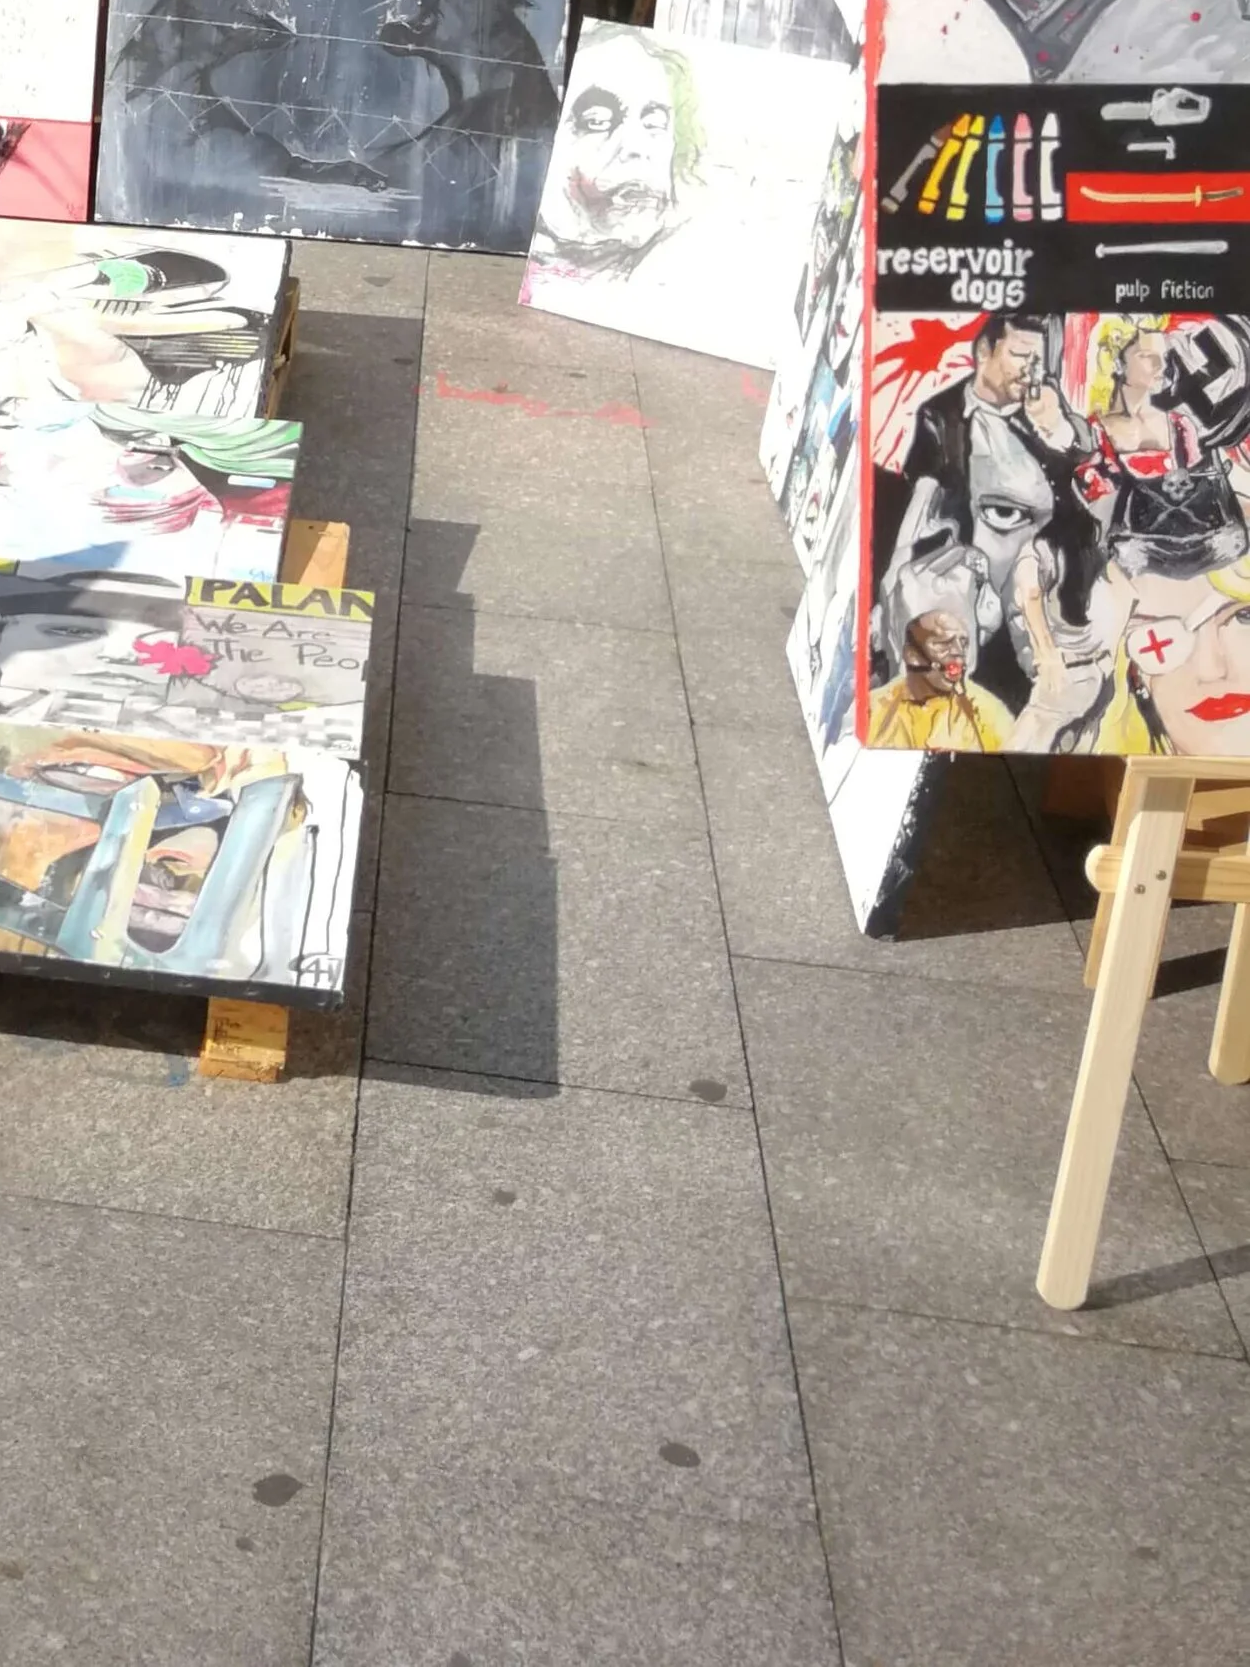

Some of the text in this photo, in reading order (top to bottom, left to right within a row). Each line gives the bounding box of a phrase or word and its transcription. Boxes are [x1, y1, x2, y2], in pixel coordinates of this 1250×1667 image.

[877, 238, 1033, 277] reservoir
[951, 269, 1027, 311] dogs
[1115, 280, 1150, 304] pulp
[192, 609, 332, 641] We Are
